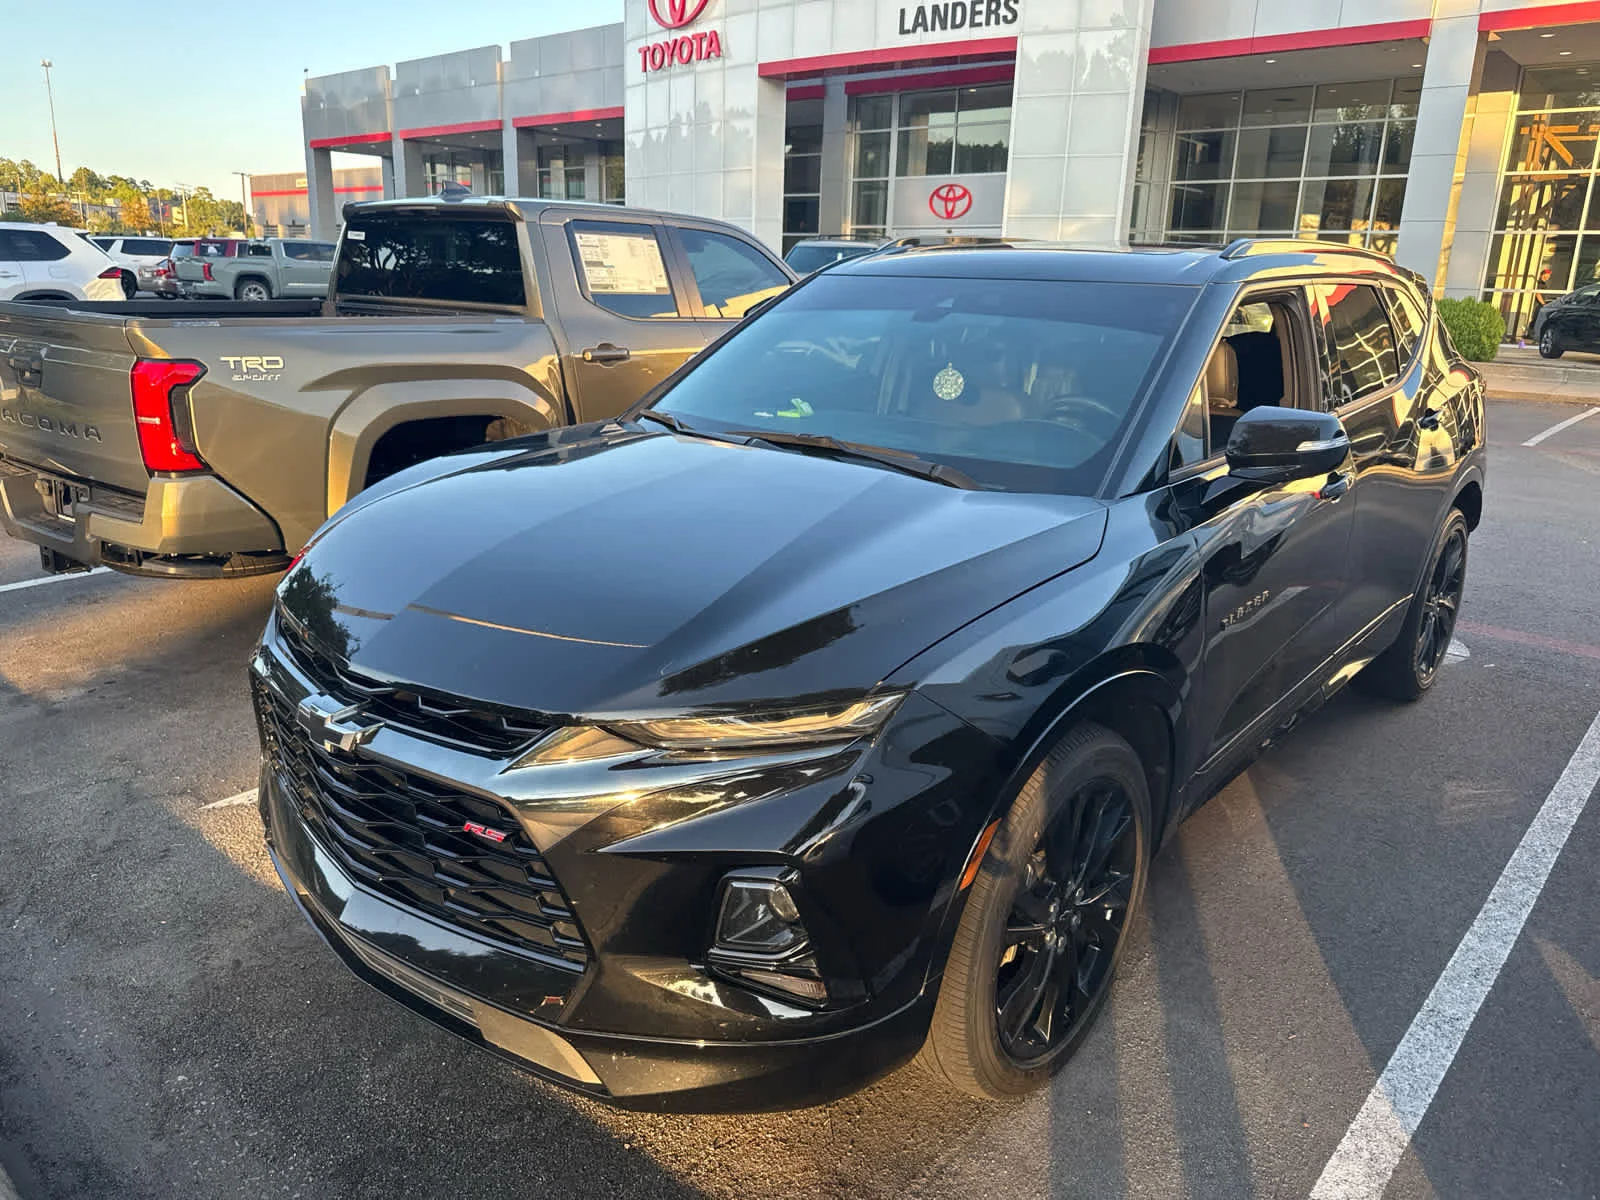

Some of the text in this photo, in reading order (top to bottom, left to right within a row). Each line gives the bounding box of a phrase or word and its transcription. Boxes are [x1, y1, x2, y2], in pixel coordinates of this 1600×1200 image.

[898, 0, 1019, 35] LANDERS
[638, 30, 721, 73] TOYOTA
[220, 356, 284, 373] TRD
[463, 821, 507, 843] RS
